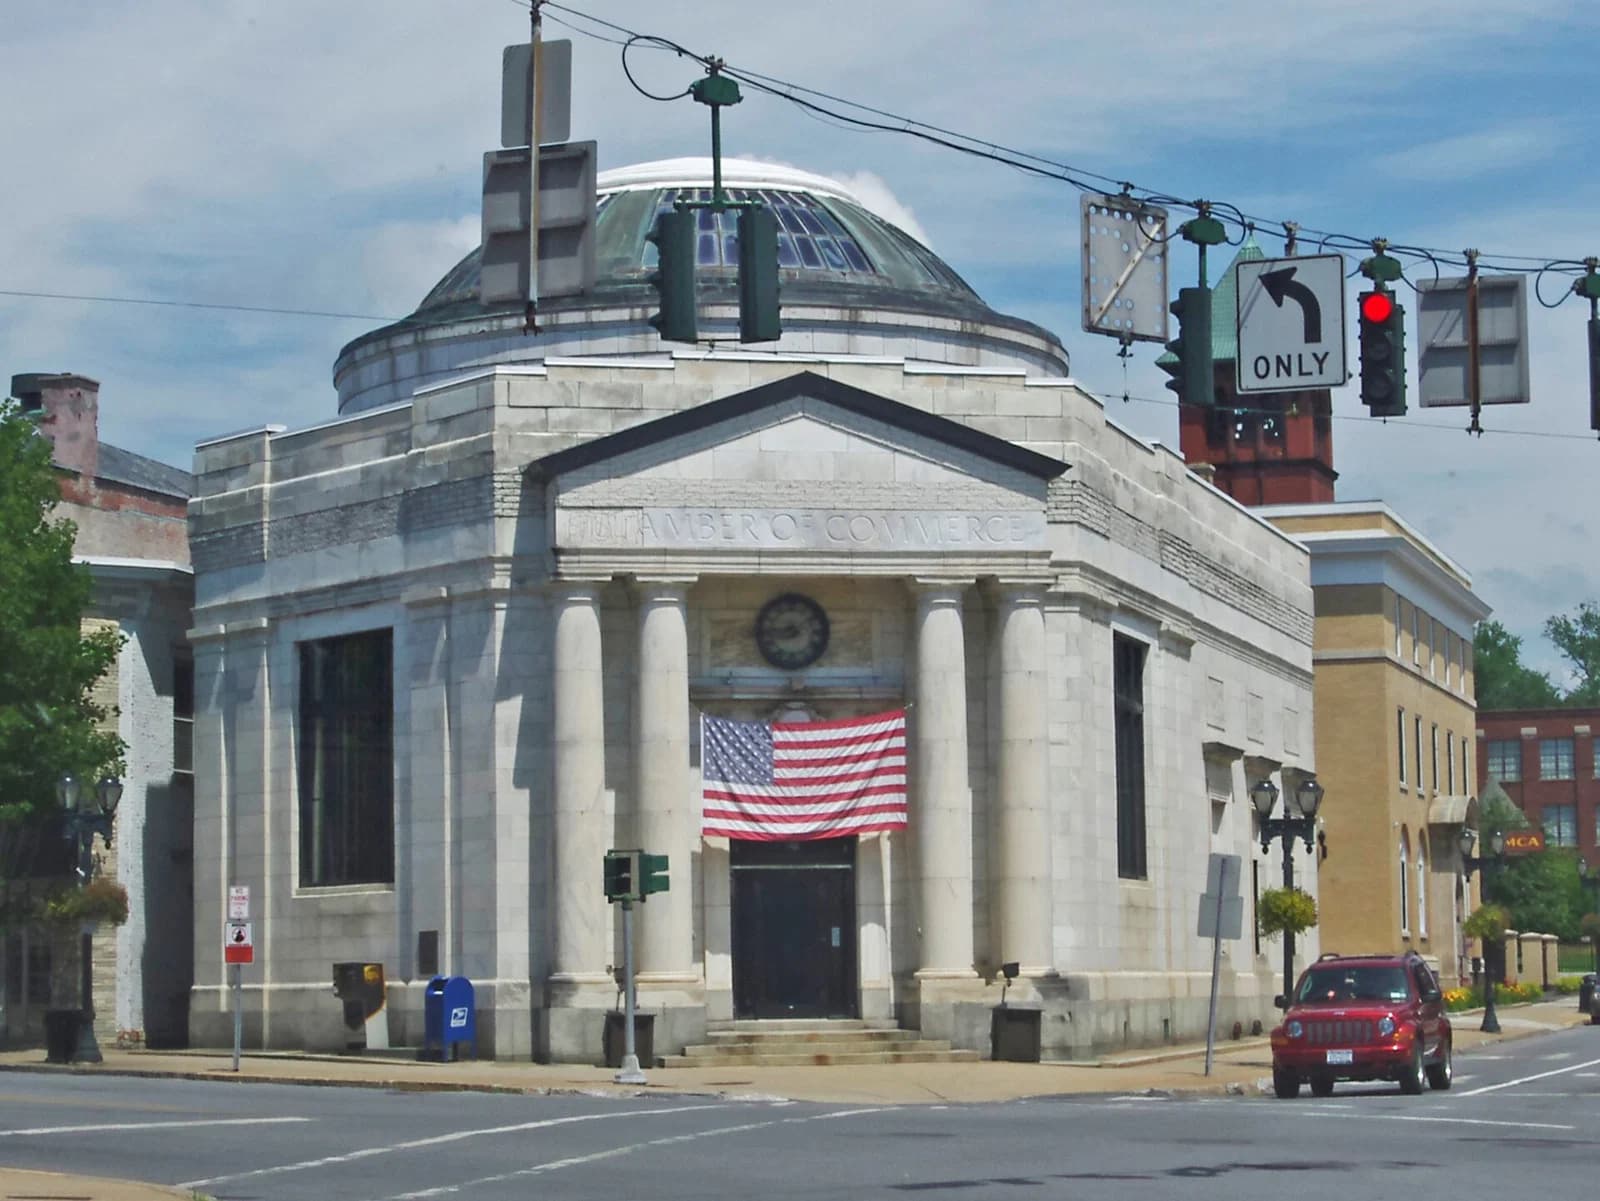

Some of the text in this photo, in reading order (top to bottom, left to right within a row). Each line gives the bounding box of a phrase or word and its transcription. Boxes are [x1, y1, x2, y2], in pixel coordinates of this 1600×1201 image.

[1253, 351, 1330, 379] ONLY
[769, 511, 816, 543] OF
[825, 512, 1025, 544] COMMERCE
[1505, 836, 1539, 847] MCA
